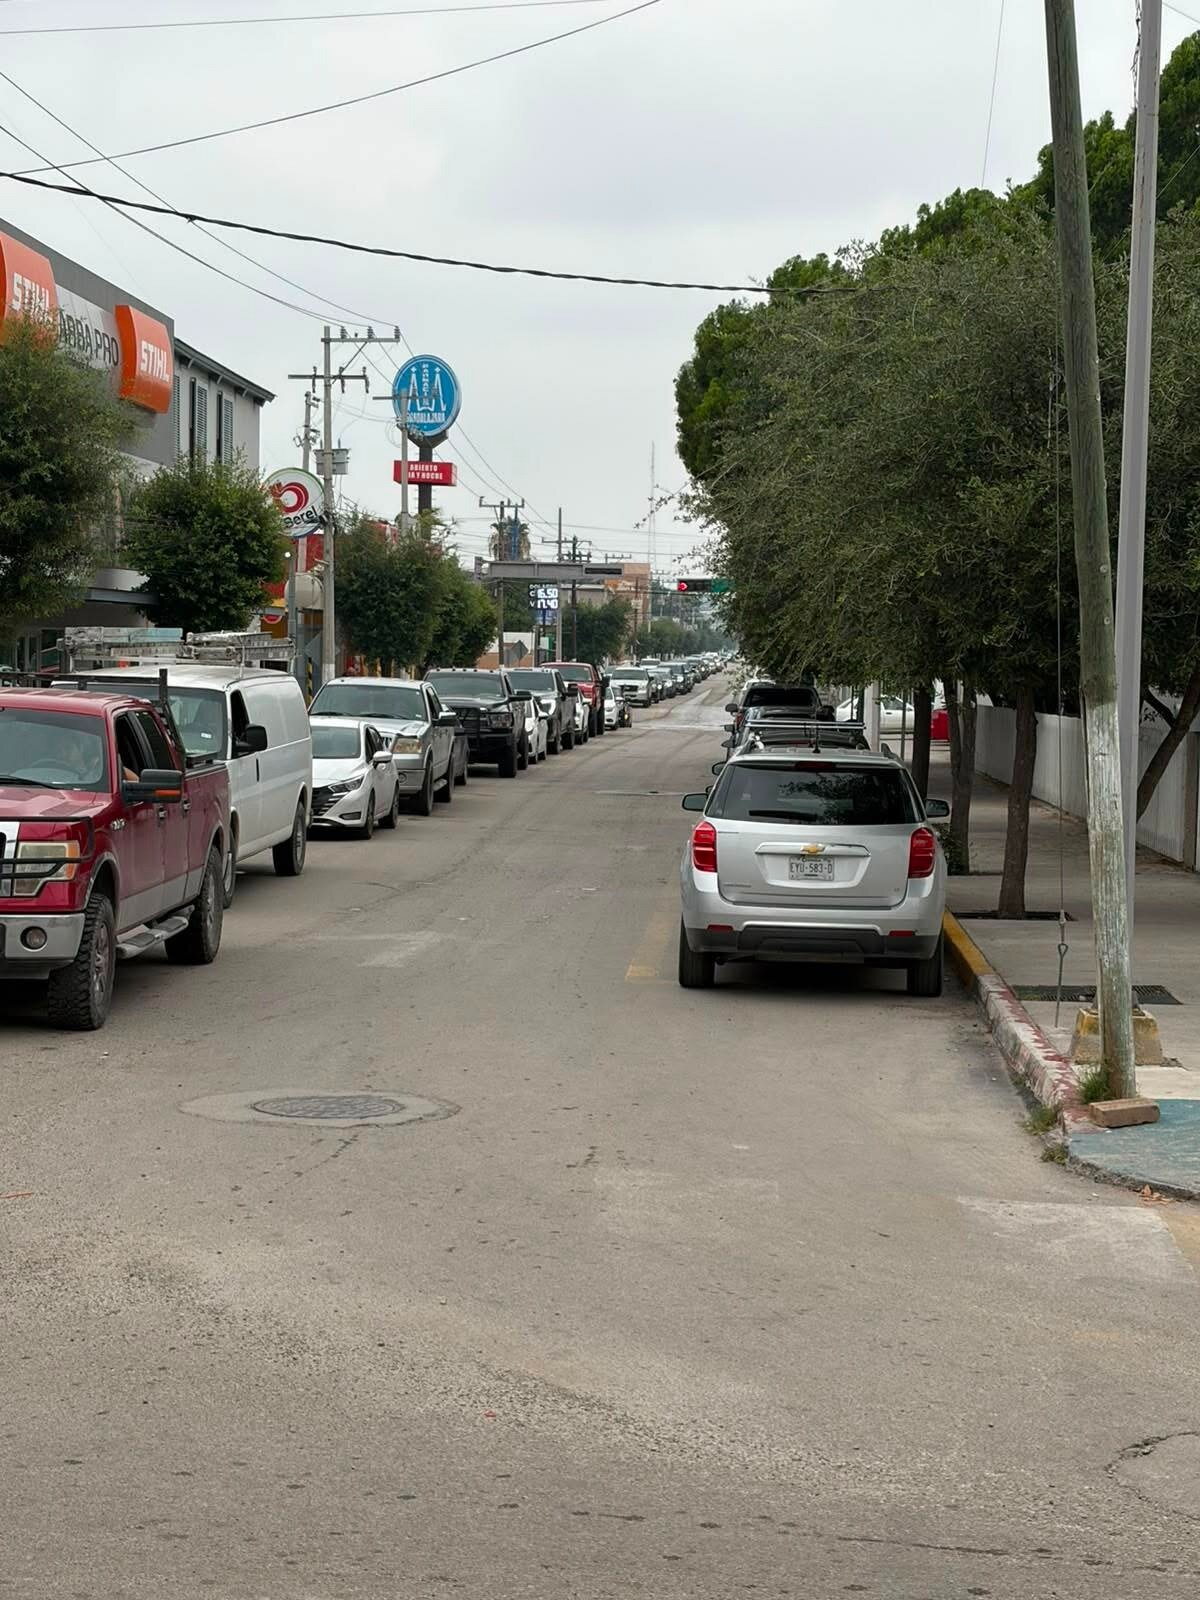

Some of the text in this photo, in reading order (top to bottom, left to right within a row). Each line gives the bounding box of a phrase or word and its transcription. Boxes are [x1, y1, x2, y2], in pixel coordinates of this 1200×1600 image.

[11, 272, 53, 323] STIHL
[94, 328, 119, 366] PRO
[140, 340, 170, 382] STIHL
[410, 464, 438, 472] ABIERTO
[283, 505, 318, 529] Berel
[537, 588, 558, 599] 16.50
[537, 599, 558, 609] 17.40
